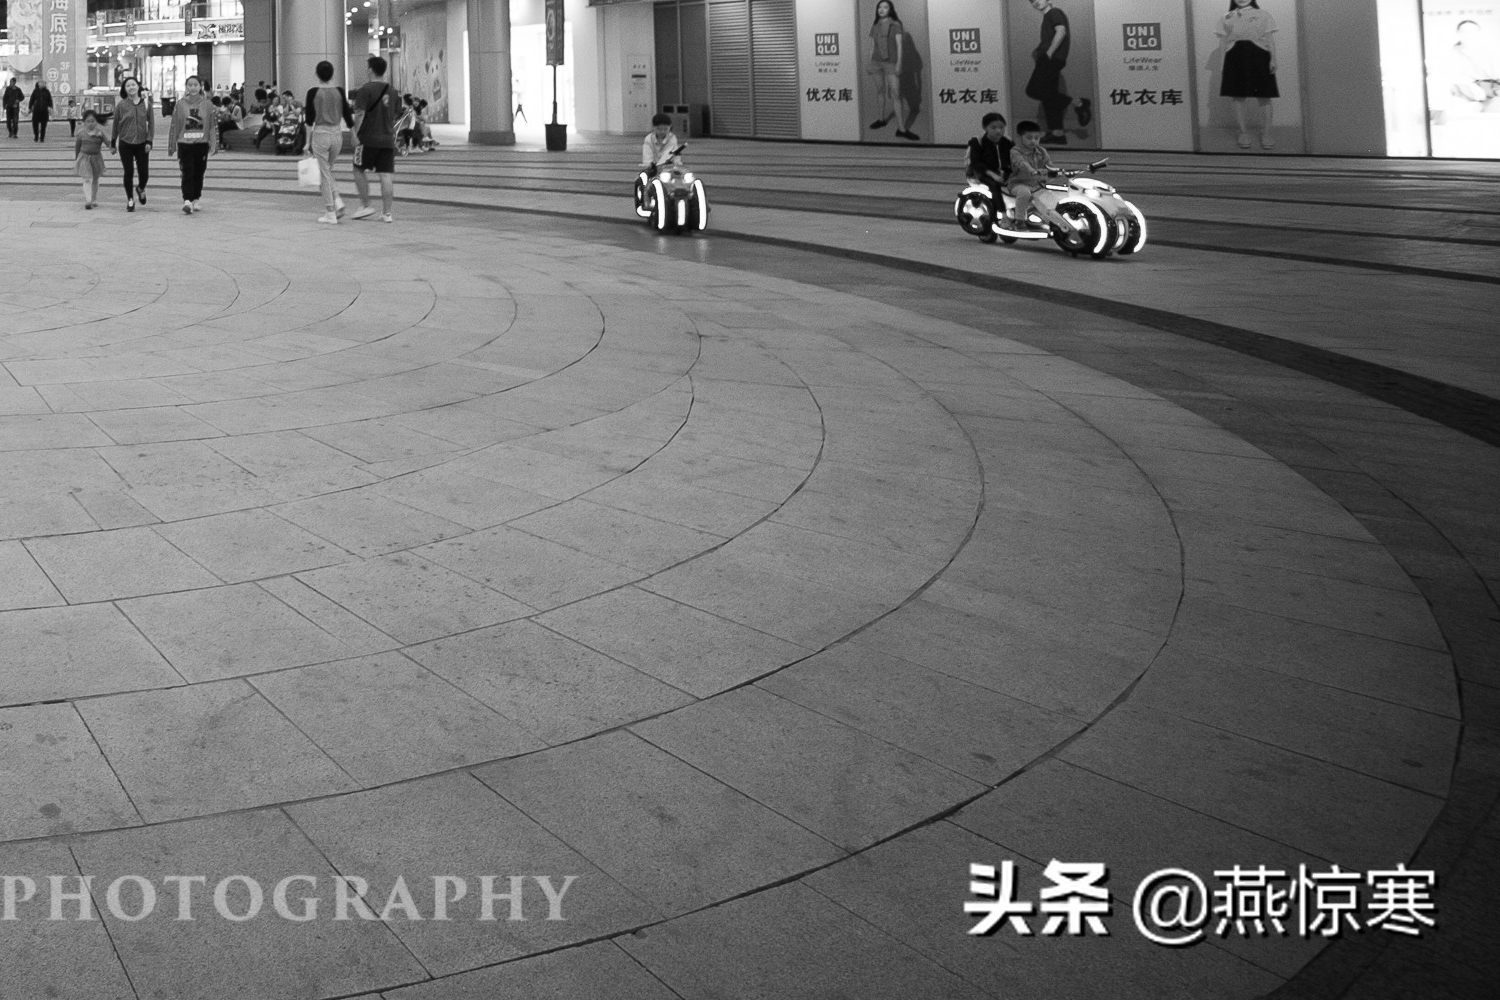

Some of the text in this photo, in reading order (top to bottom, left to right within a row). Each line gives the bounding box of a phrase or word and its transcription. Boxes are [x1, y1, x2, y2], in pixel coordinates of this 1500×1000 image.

[952, 30, 975, 41] UNI
[1126, 26, 1154, 36] UNI
[816, 34, 836, 45] UNI
[1127, 37, 1157, 49] QLO
[817, 44, 837, 55] QLO
[953, 41, 977, 53] QLO
[806, 87, 853, 103] 优衣库
[939, 88, 999, 104] 优衣库
[1110, 88, 1183, 105] 优衣库
